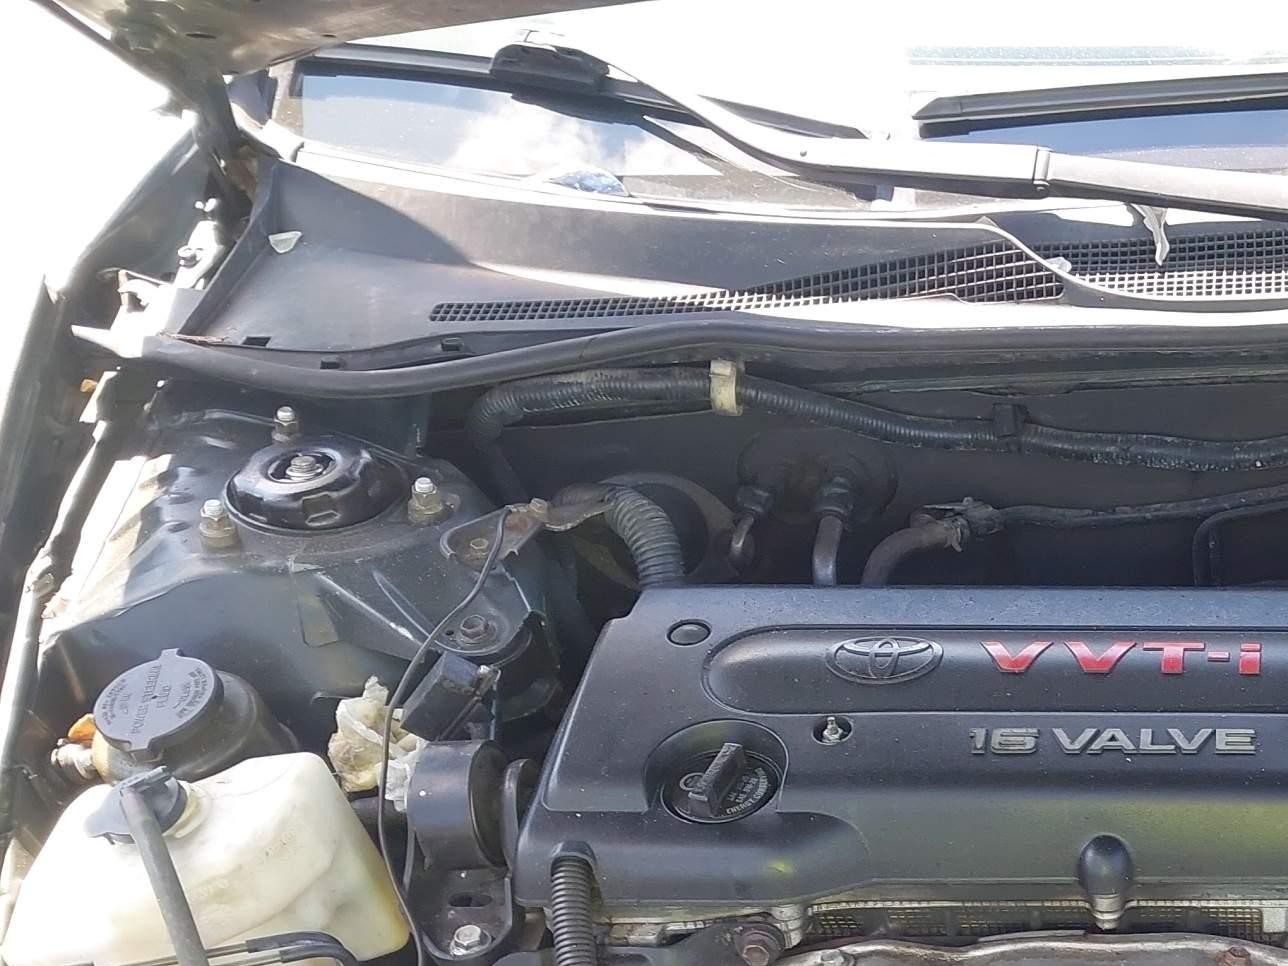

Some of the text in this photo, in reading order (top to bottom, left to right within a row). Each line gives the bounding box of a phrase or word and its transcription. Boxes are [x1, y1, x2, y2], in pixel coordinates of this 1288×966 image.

[980, 640, 1262, 675] VVT-i
[969, 727, 1256, 755] 16 VALVE
